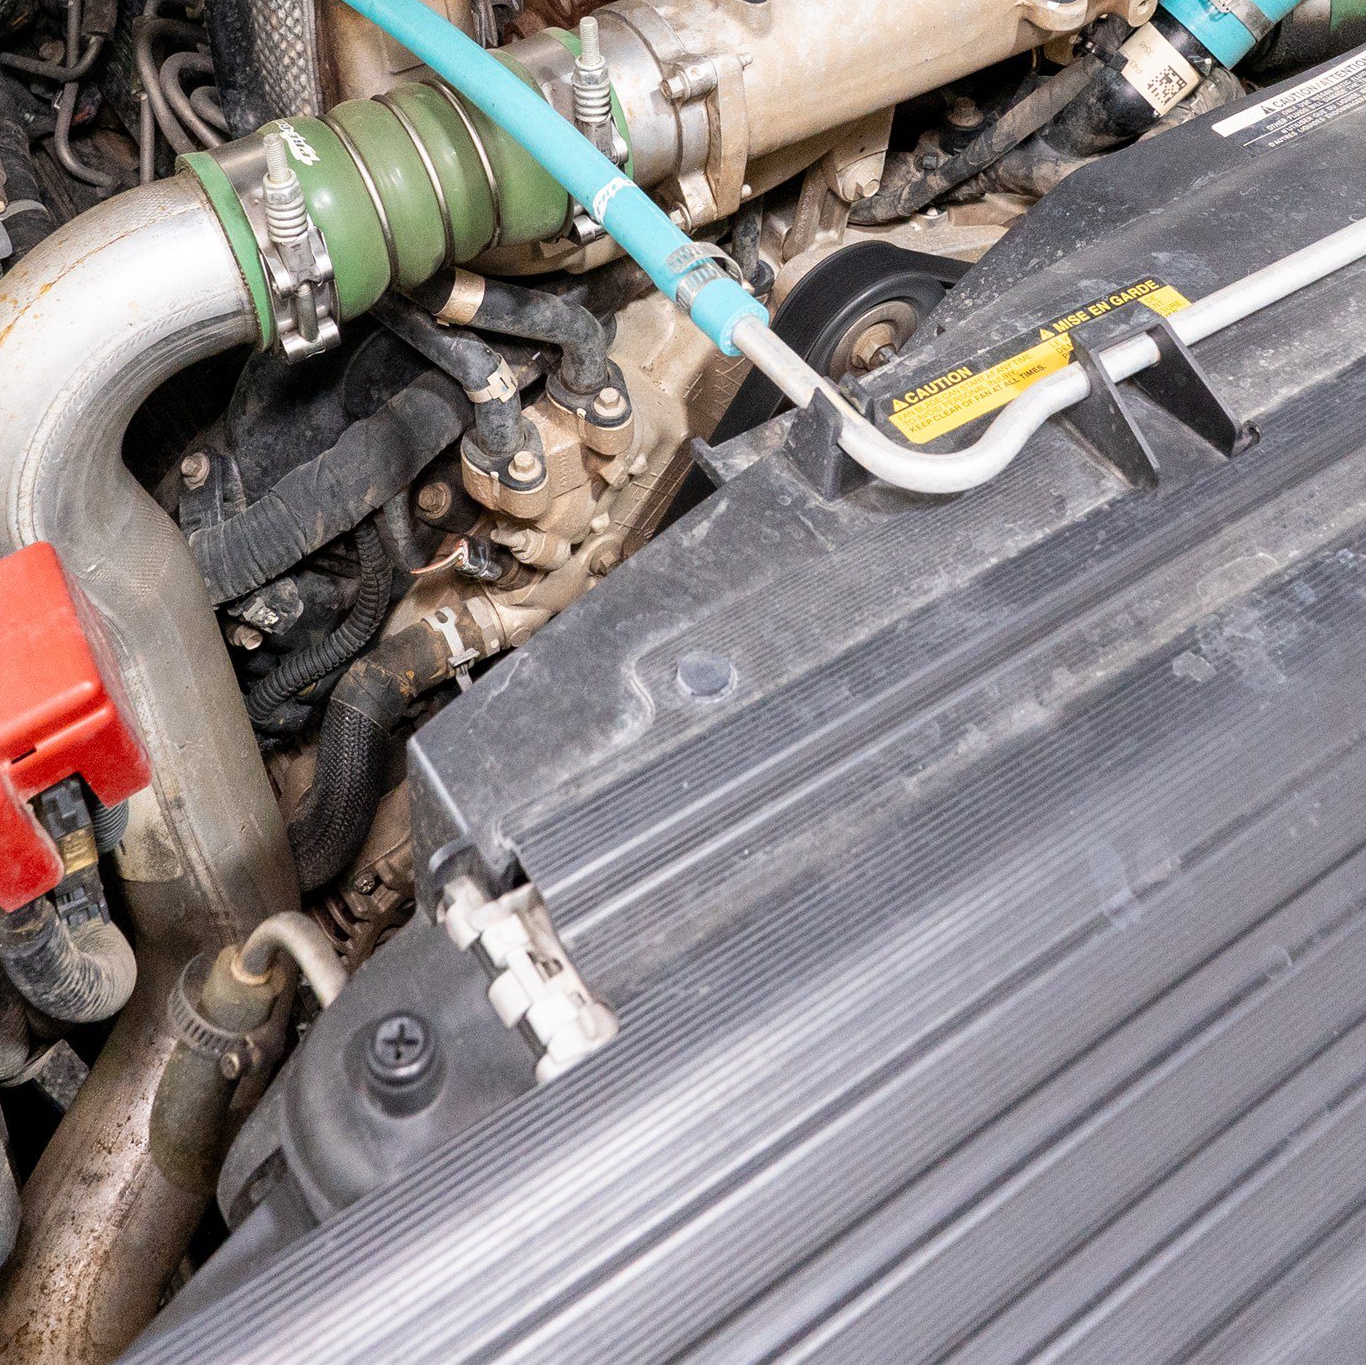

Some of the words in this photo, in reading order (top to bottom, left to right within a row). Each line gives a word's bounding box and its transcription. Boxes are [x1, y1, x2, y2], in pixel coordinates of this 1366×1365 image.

[1052, 310, 1091, 333] MISE
[1087, 300, 1111, 317] EN
[1109, 279, 1160, 307] GARDE
[898, 409, 916, 422] FAN
[916, 398, 942, 415] BLADE
[941, 388, 961, 403] CAN
[959, 376, 987, 396] START
[996, 362, 1014, 379] ANY
[903, 416, 917, 427] TO
[917, 403, 943, 423] AVOID
[943, 383, 988, 413] PERSONAL
[904, 366, 973, 405] CAUTION
[909, 420, 933, 434] KEEP
[933, 404, 962, 423] CLEAR
[962, 397, 975, 409] OF
[975, 389, 993, 403] FAN
[992, 384, 1005, 395] AT
[1004, 376, 1020, 391] ALL
[1019, 364, 1048, 382] TIMES.
